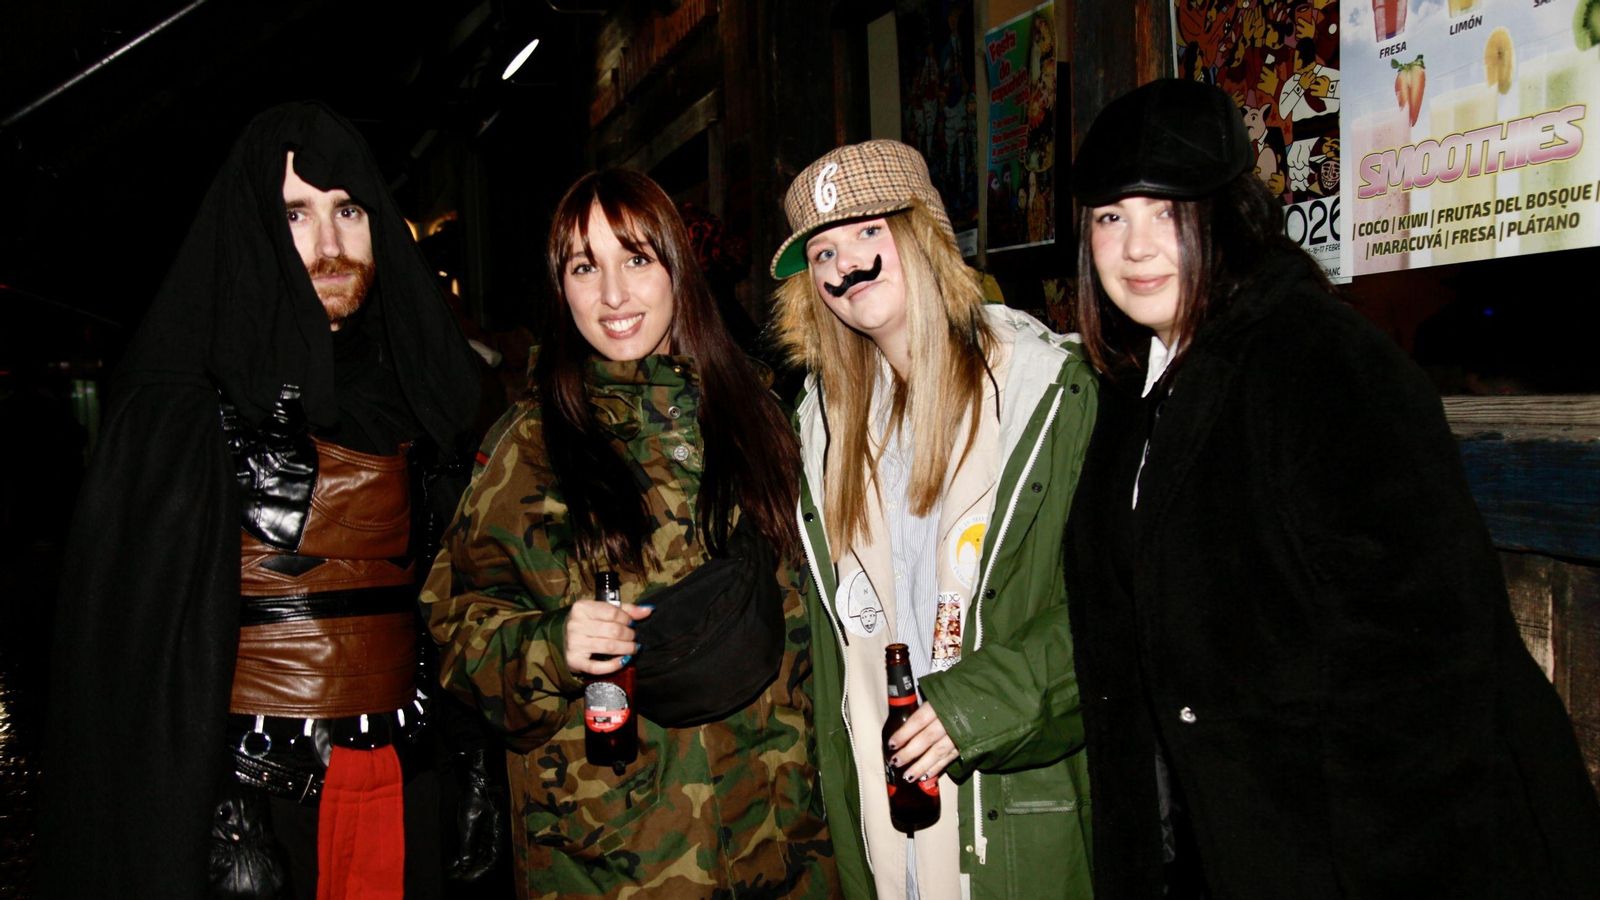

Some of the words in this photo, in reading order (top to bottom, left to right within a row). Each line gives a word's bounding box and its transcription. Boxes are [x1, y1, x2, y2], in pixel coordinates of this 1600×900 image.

[1449, 15, 1483, 36] LIMÓN
[1379, 41, 1407, 59] FRESA
[1358, 105, 1586, 199] SMOOTHIES
[1358, 219, 1389, 237] COCO
[1398, 212, 1429, 231] KIWI
[1437, 201, 1491, 225] FRUTAS
[1494, 196, 1522, 215] DEL
[1526, 184, 1593, 209] BOSQUE
[1371, 228, 1442, 257] MARACUYÁ
[1451, 225, 1496, 245] FRESA
[1507, 212, 1580, 238] PLÁTANO
